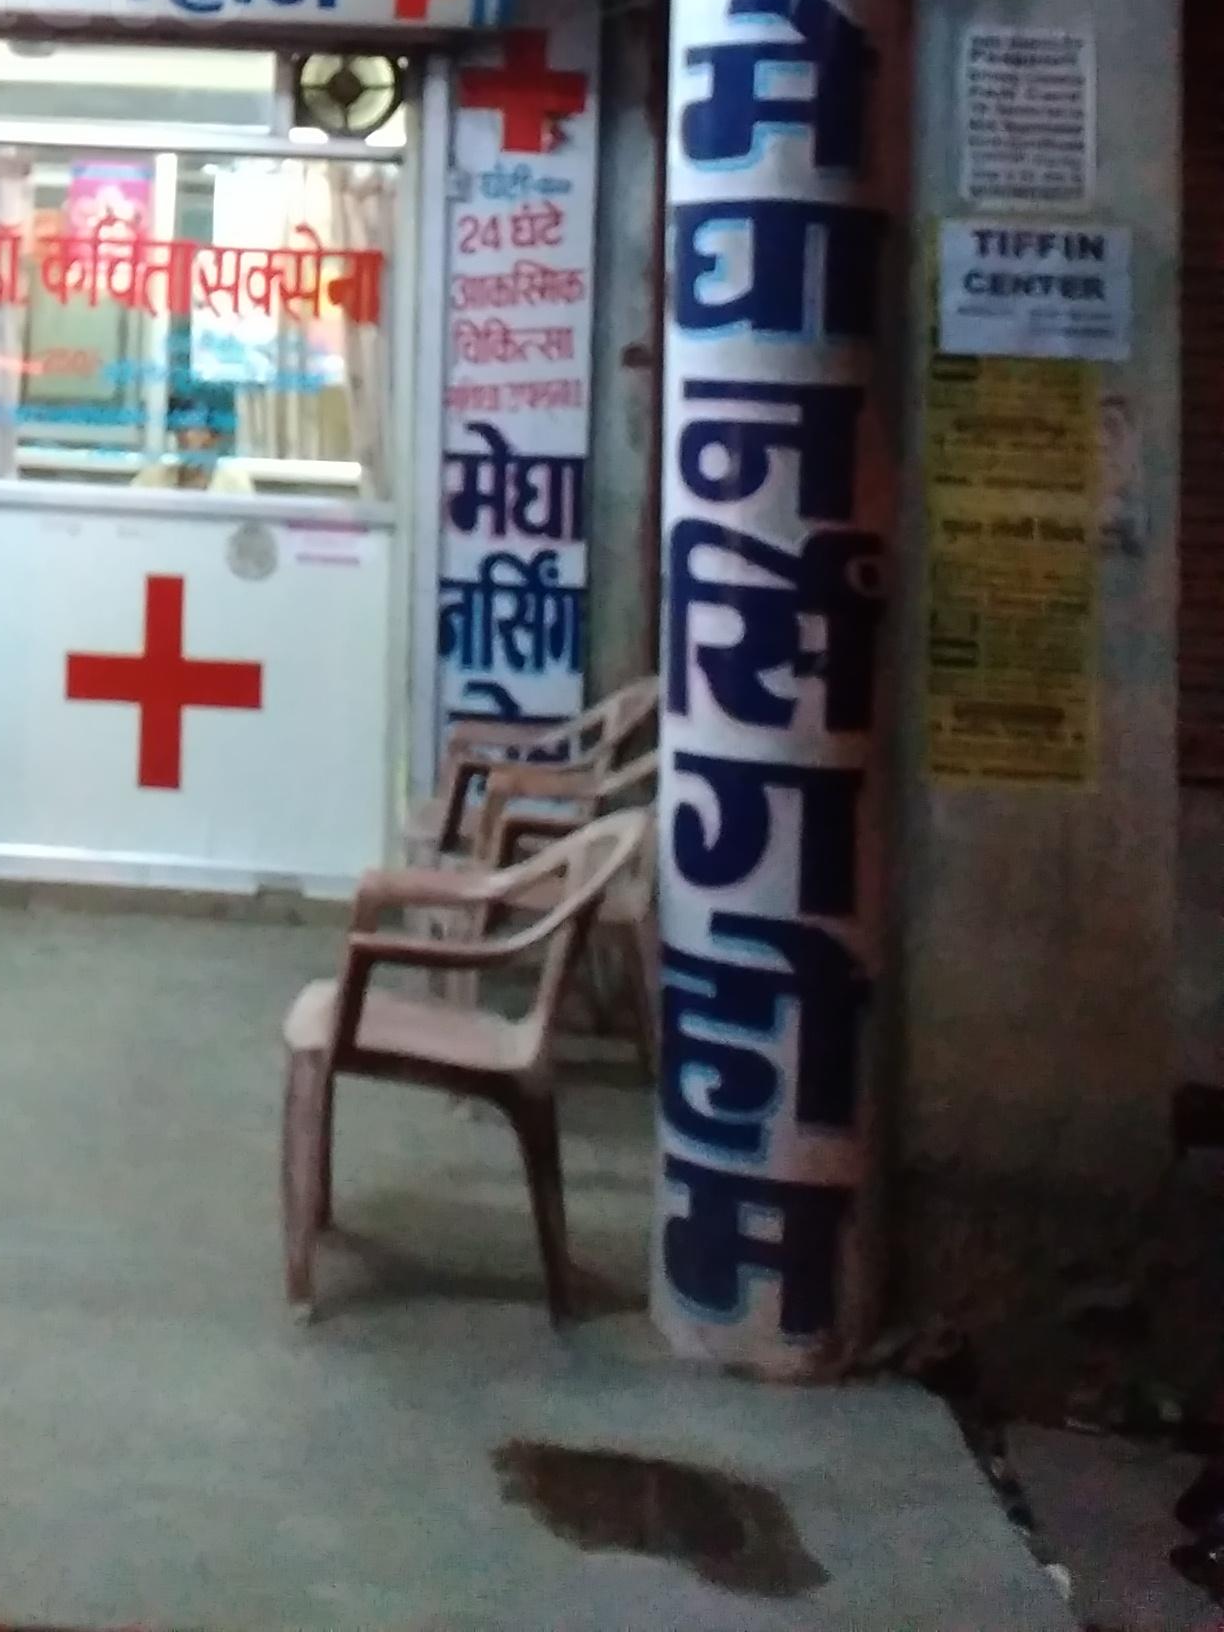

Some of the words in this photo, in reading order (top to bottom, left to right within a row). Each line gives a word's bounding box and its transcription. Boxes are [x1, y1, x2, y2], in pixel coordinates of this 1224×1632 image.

[457, 213, 503, 256] 24
[973, 229, 1106, 262] TIFFIN
[962, 270, 1107, 302] CENTER
[441, 420, 586, 540] मेघा
[439, 551, 586, 676] नर्सिंग
